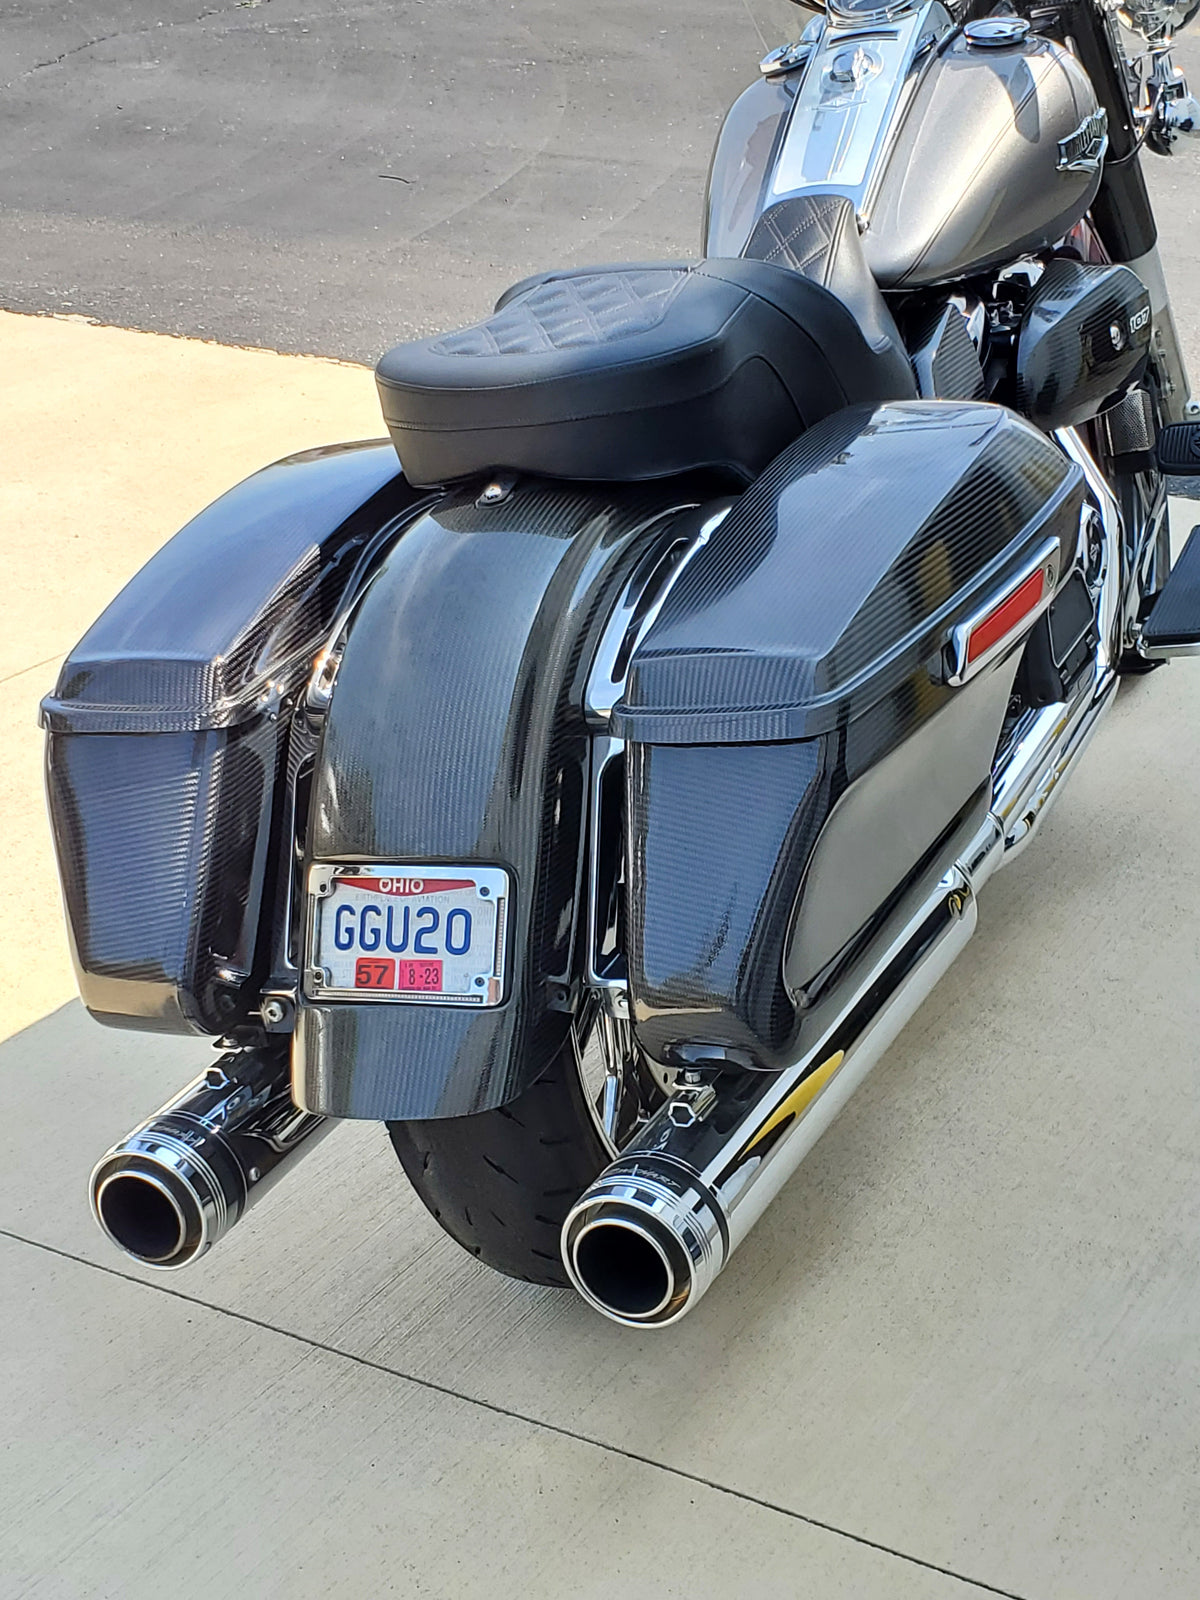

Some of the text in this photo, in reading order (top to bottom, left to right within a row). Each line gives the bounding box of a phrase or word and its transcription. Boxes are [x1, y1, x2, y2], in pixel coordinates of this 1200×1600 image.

[1130, 306, 1150, 333] 107
[379, 879, 424, 893] OHIO
[334, 904, 472, 956] GGU20
[356, 966, 389, 985] 57
